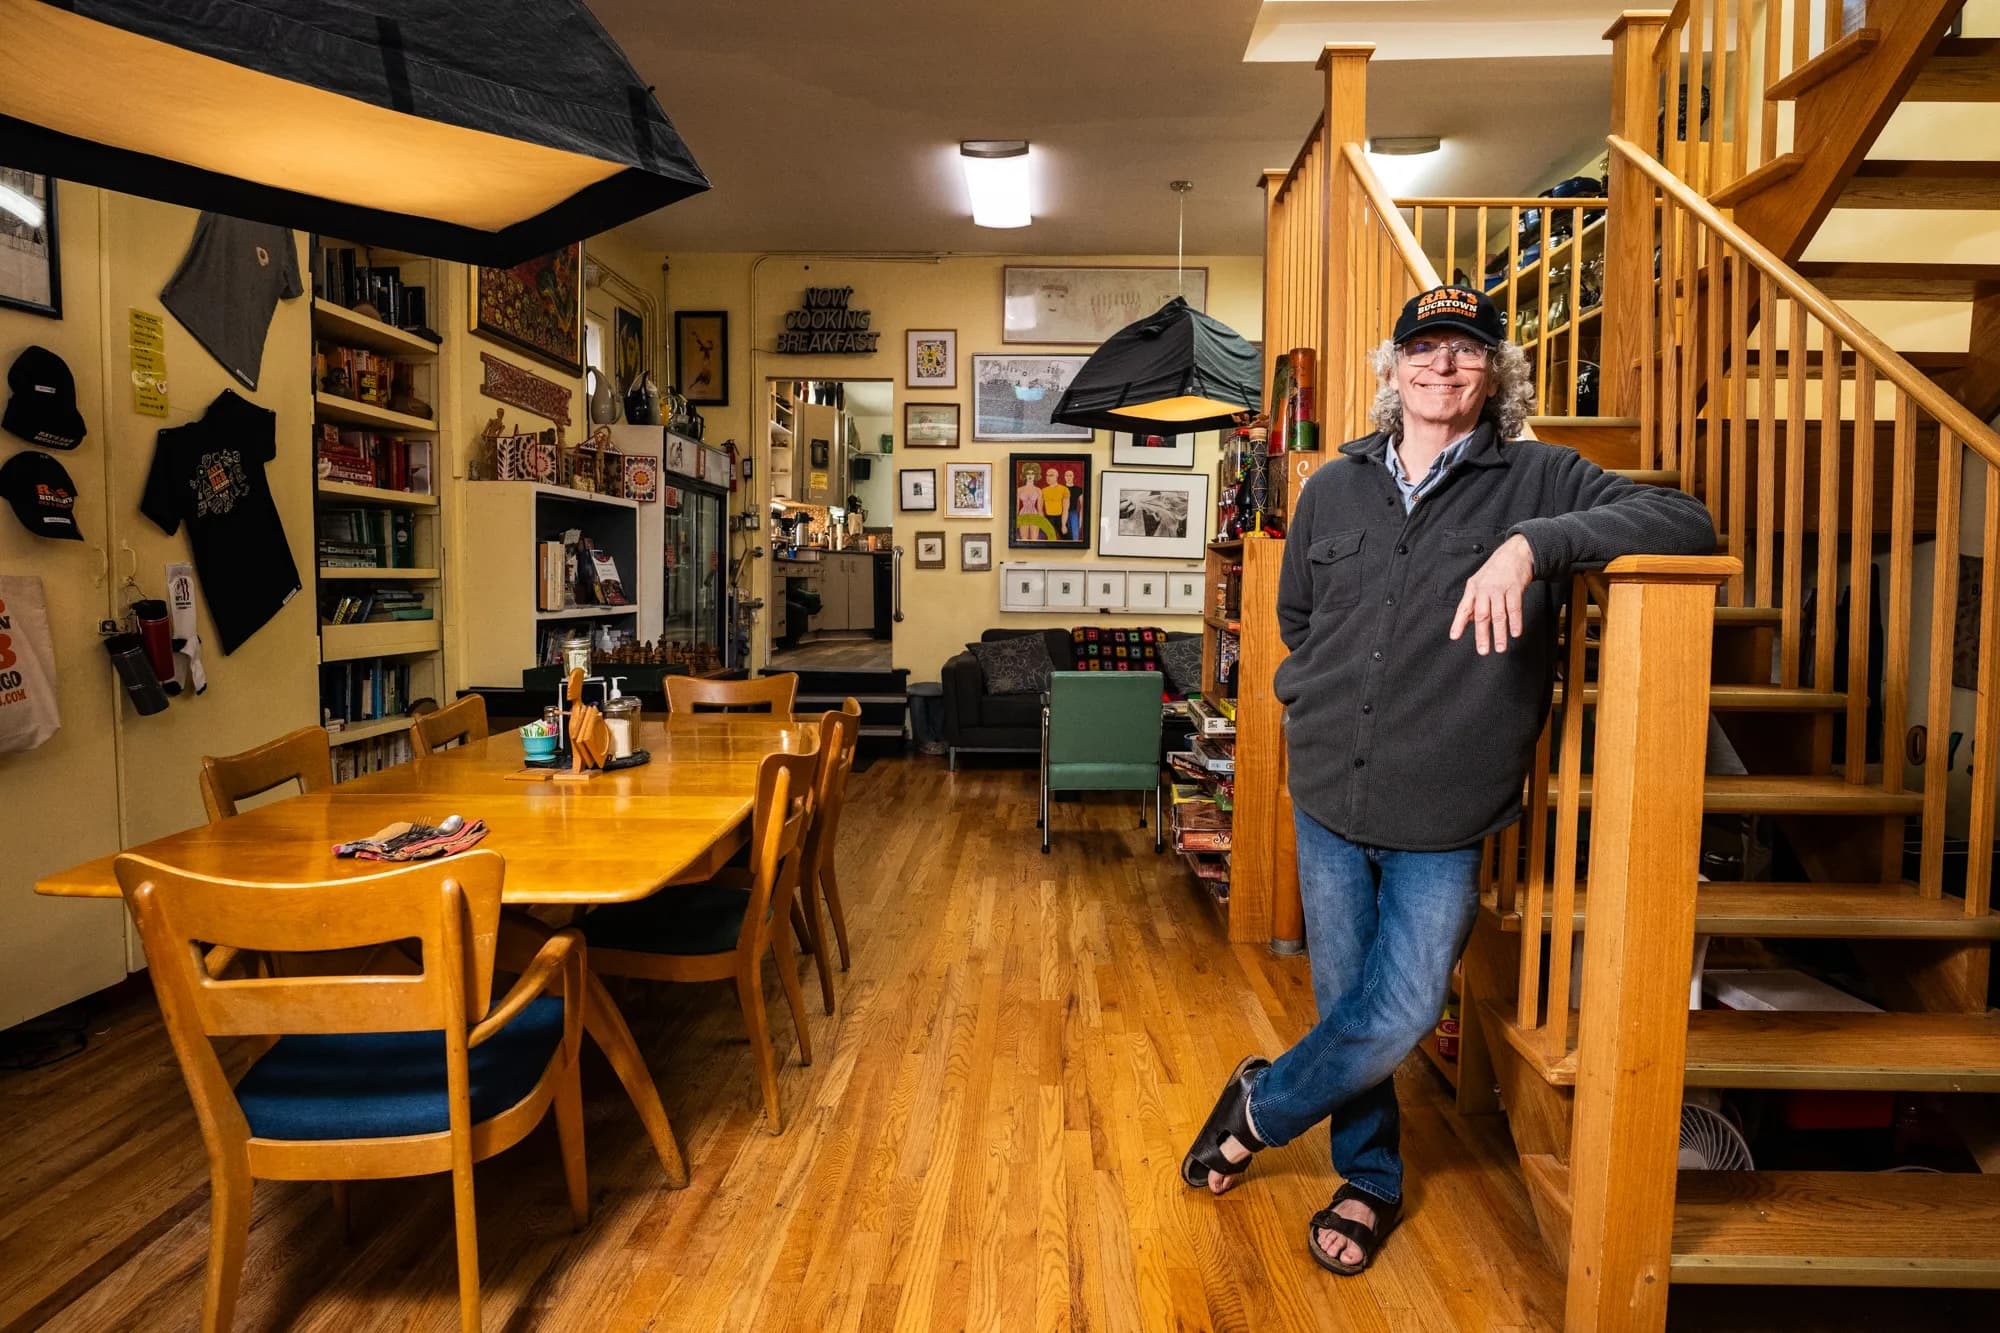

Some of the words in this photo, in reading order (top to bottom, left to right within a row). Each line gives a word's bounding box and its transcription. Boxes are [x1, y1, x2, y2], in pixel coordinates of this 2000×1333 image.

[803, 287, 853, 308] NOW
[1418, 289, 1478, 306] RAY'S
[1417, 300, 1478, 315] BUCKTOWN
[1437, 307, 1477, 318] BREAKFAST
[784, 309, 871, 330] COOKING
[776, 331, 880, 353] BREAKFAST
